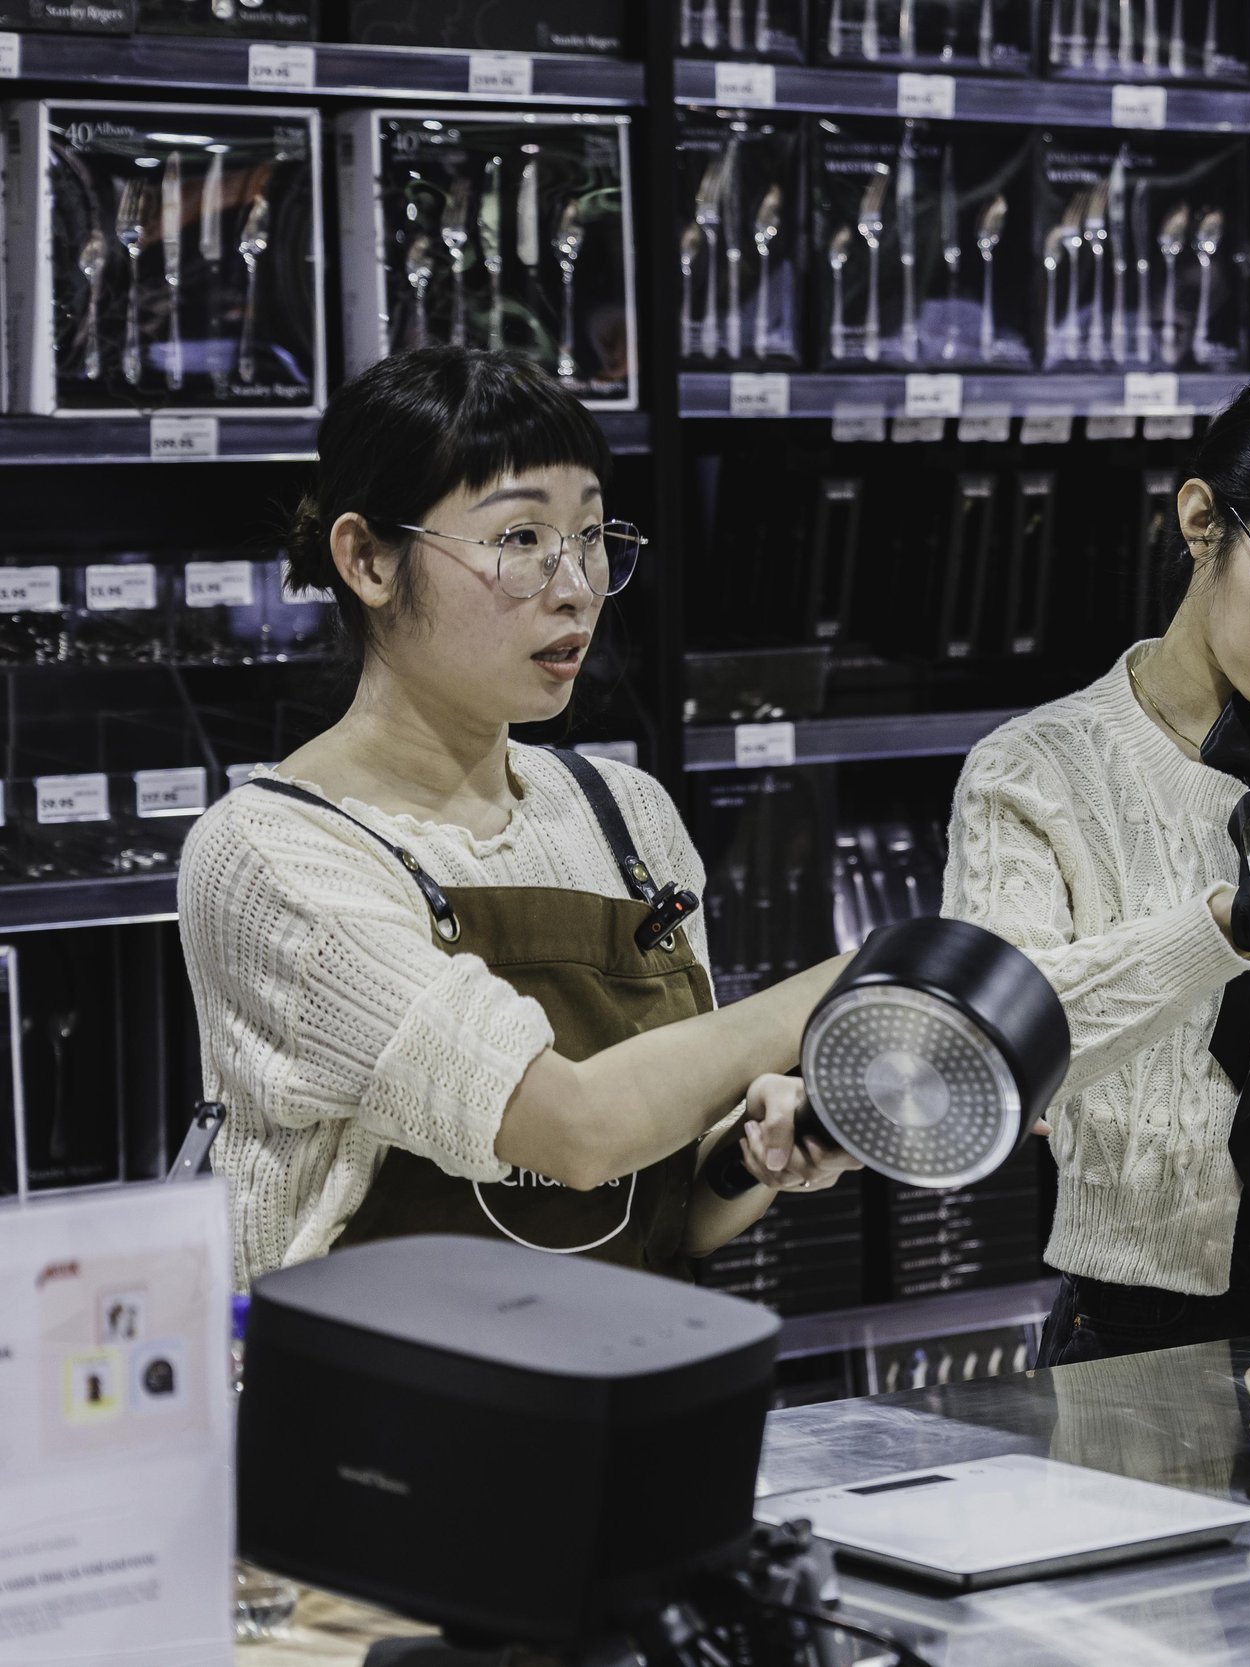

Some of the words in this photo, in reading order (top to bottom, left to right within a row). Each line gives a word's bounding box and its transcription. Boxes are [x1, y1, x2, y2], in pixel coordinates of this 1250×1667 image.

[45, 5, 85, 21] Stanley
[87, 7, 125, 24] Rogers
[65, 122, 94, 143] 40
